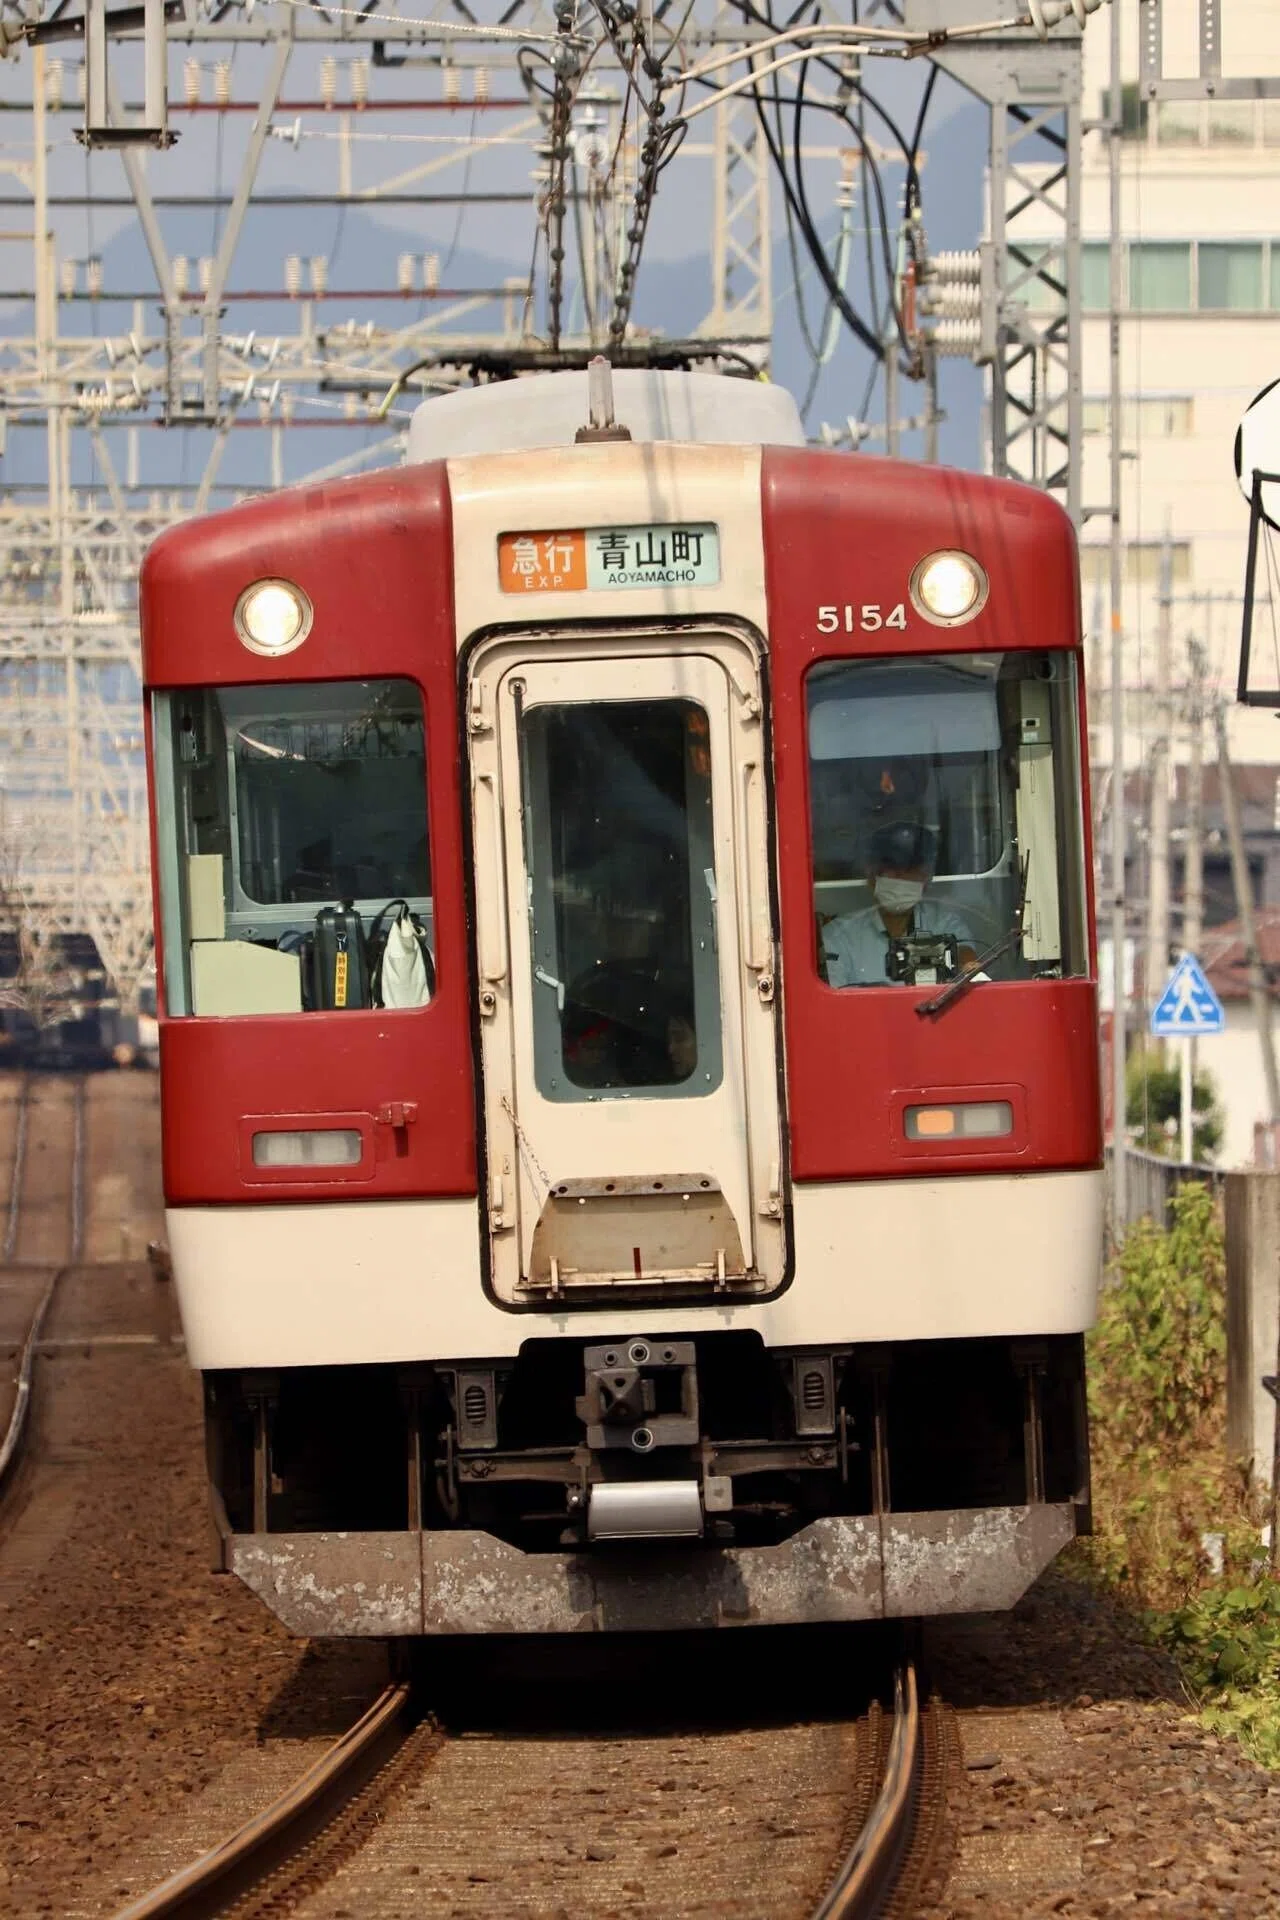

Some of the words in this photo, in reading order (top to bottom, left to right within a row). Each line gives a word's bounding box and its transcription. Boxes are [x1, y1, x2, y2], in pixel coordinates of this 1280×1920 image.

[511, 536, 574, 575] 急行
[597, 531, 703, 570] 青山町
[608, 569, 696, 584] AOYAMACHO
[816, 603, 907, 633] 5154
